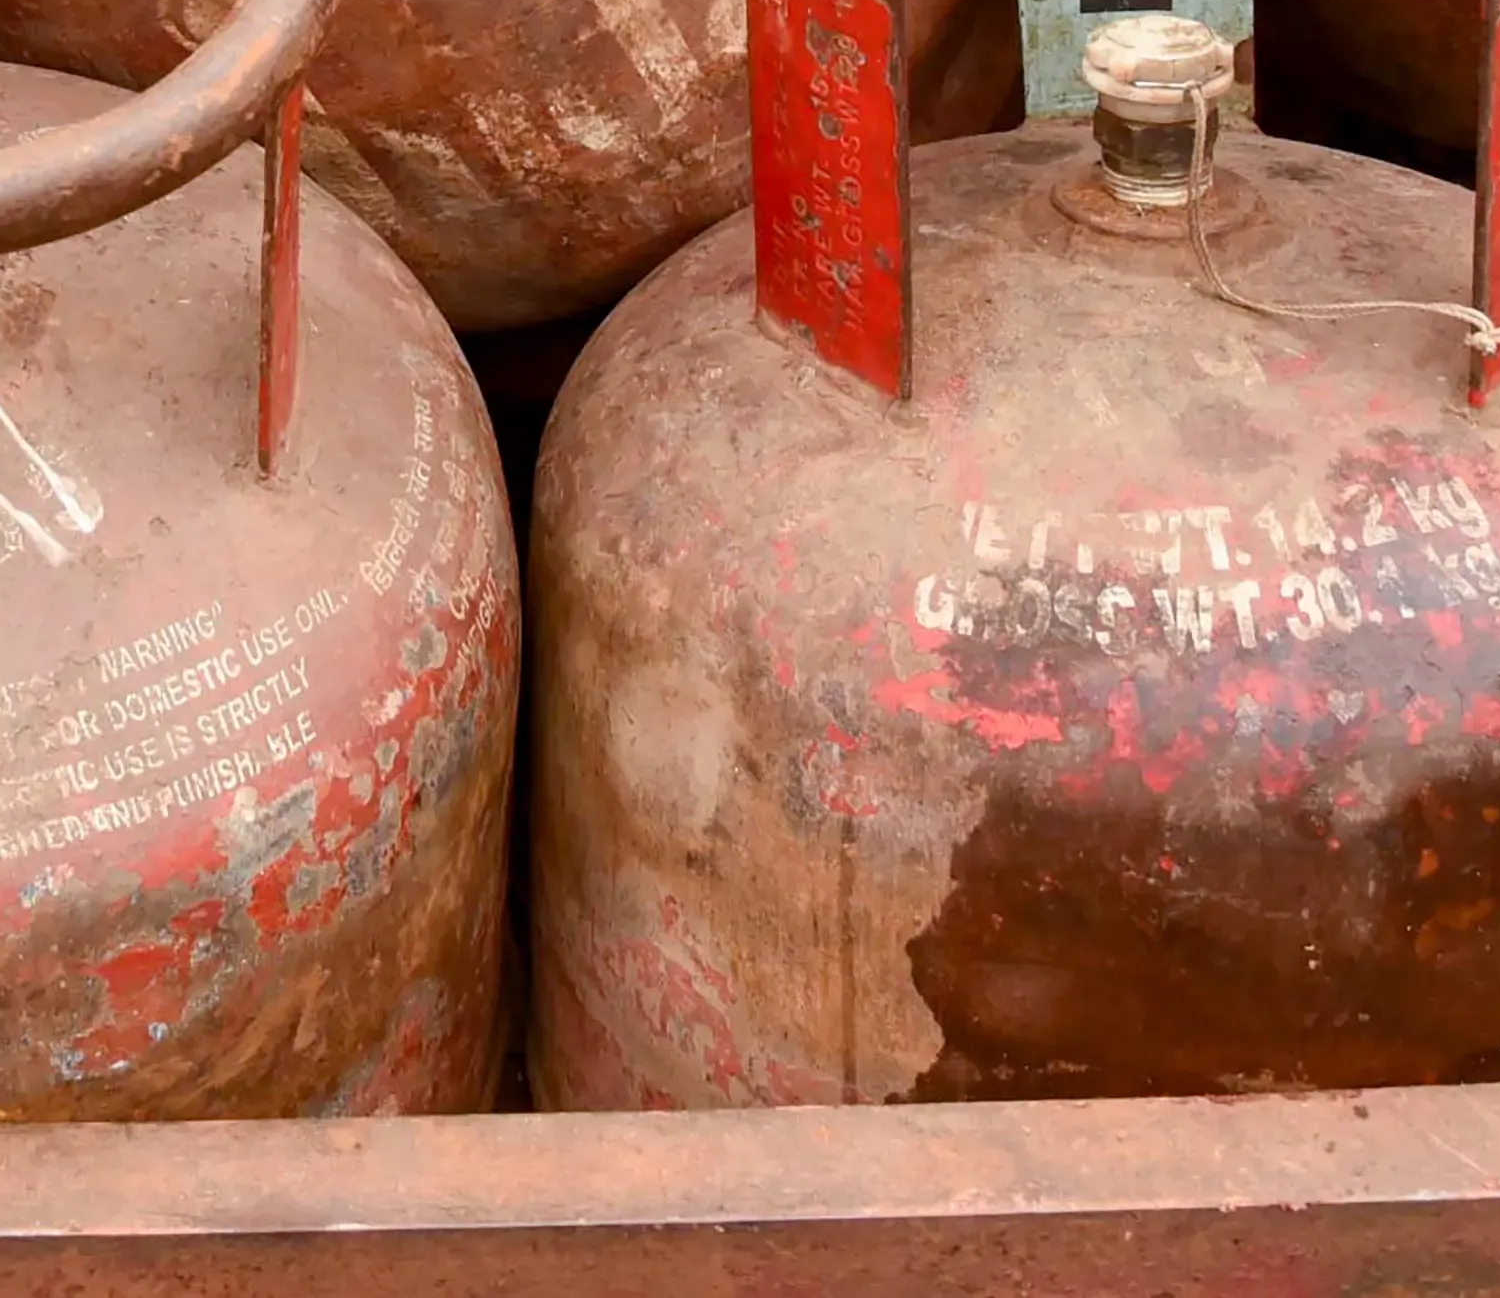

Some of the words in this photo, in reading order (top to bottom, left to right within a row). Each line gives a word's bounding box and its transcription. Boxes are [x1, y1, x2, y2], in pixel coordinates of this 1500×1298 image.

[1256, 493, 1396, 564] 14.2
[105, 645, 243, 730] DOMESTIC
[241, 624, 294, 674] USE
[194, 653, 314, 751] STRICTLY
[156, 709, 320, 822] PUNISHBLE
